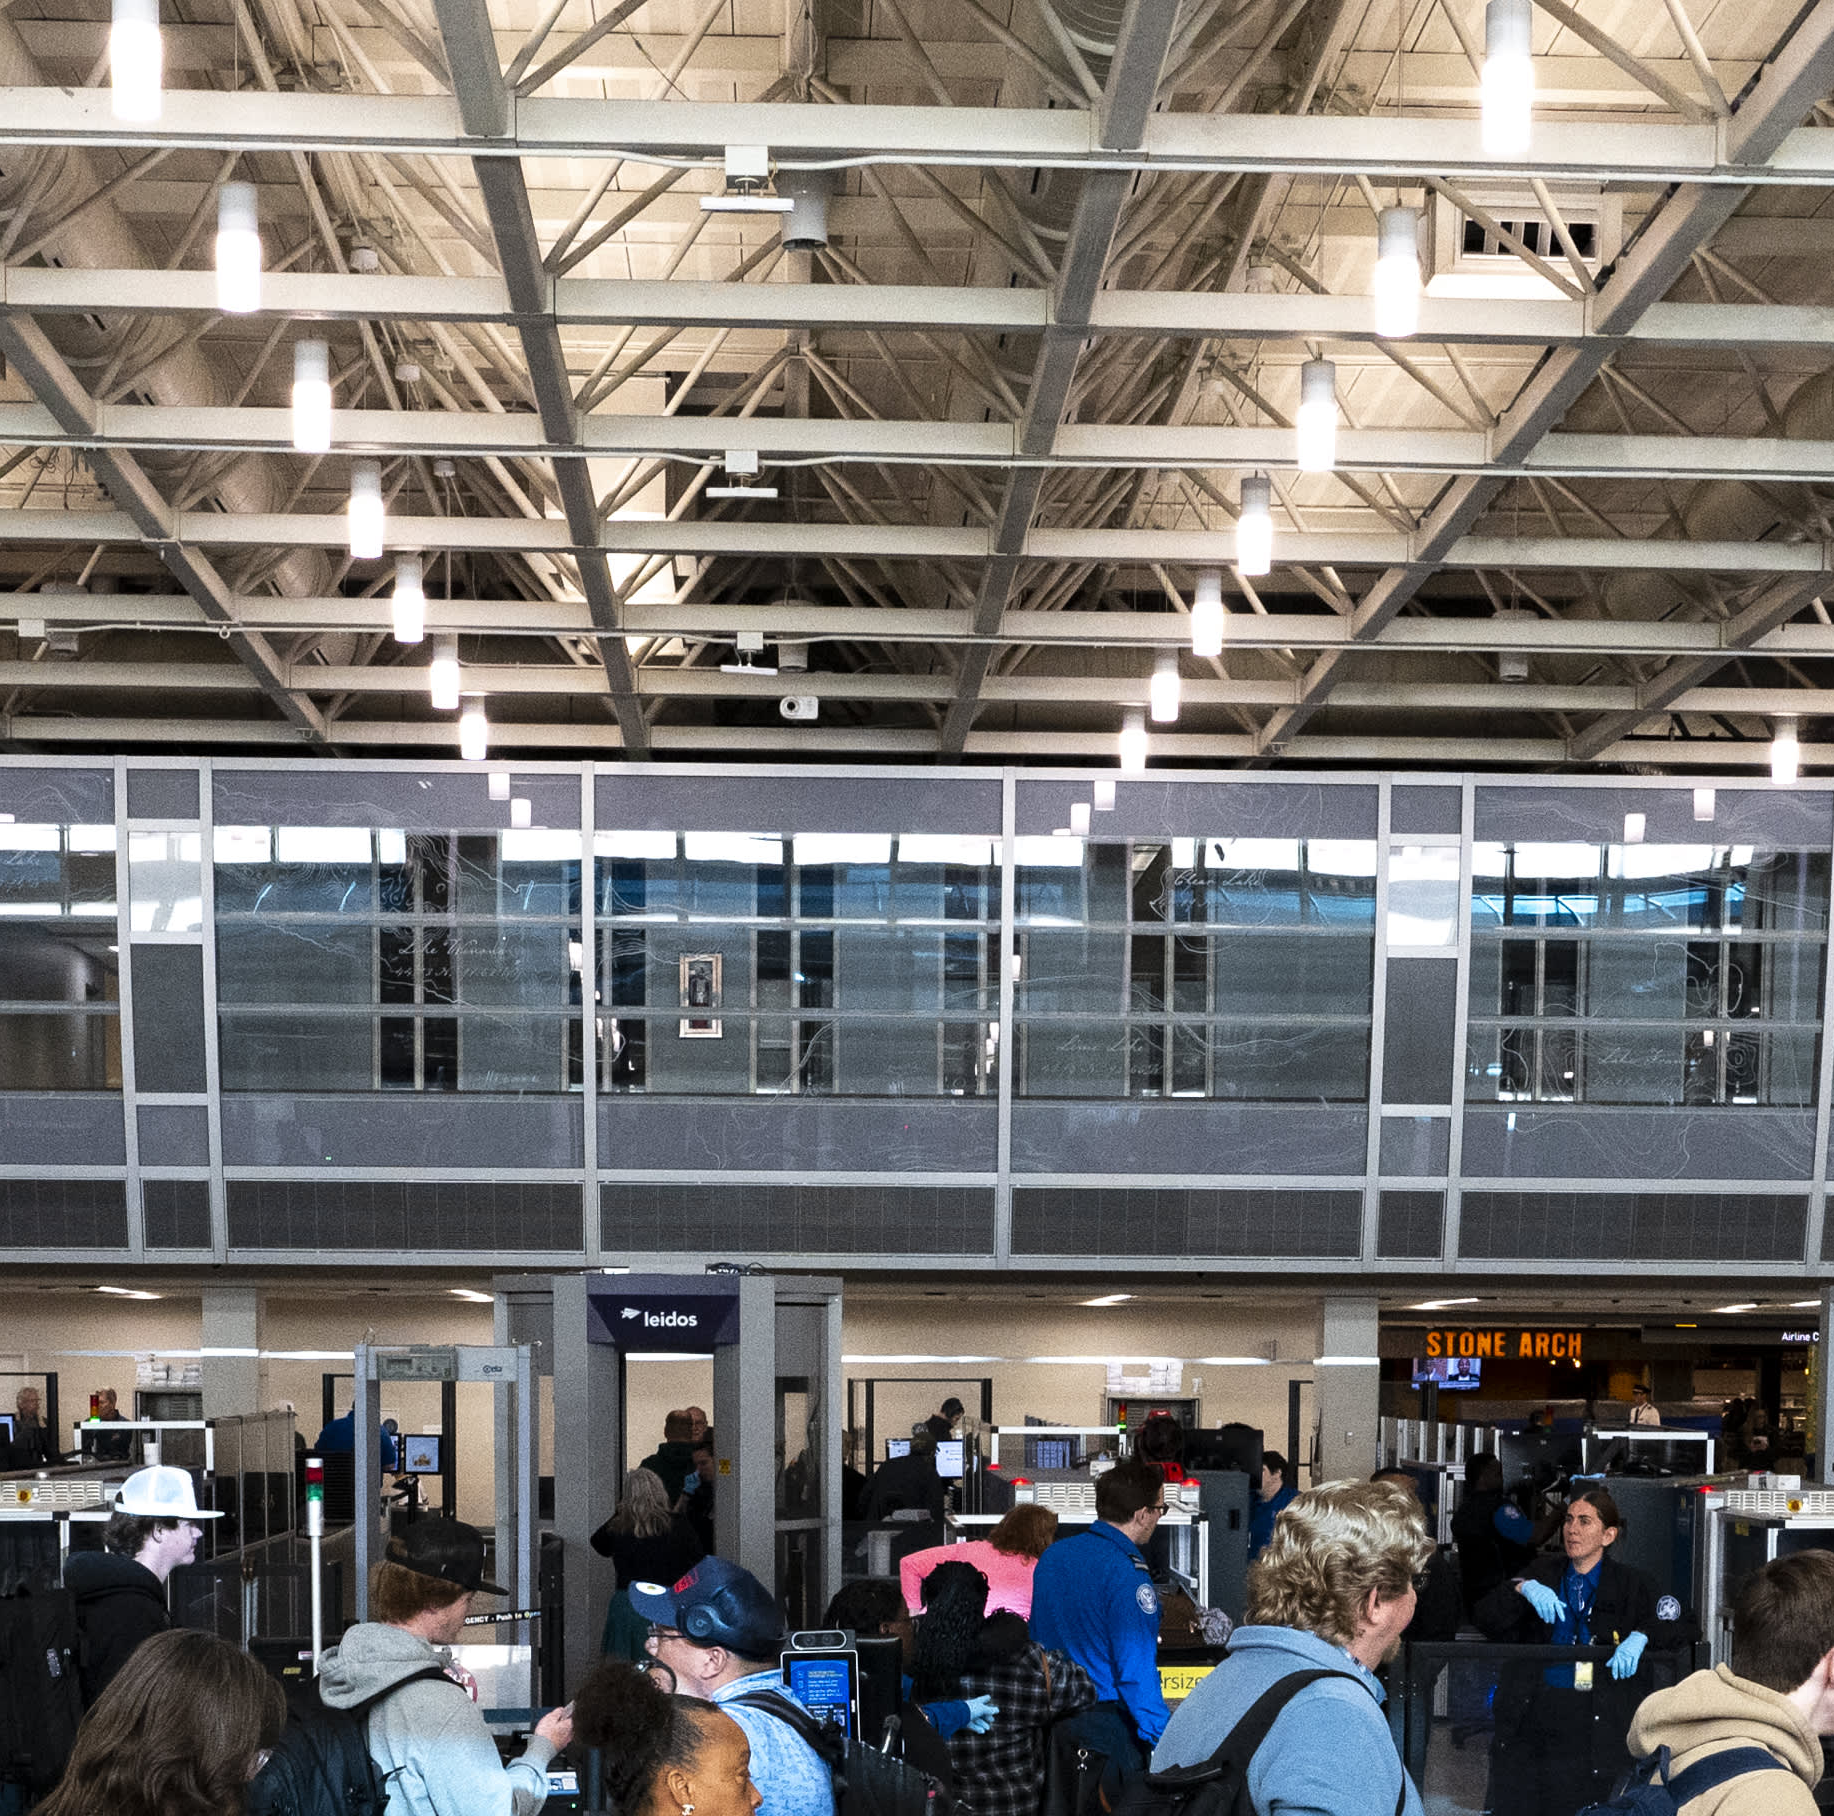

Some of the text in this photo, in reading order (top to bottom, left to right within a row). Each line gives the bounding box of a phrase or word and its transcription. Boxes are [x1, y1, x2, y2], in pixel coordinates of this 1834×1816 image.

[644, 1311, 698, 1328] leidos
[1782, 1332, 1811, 1342] Airline
[1426, 1332, 1582, 1358] STONE ARCH
[465, 1615, 488, 1624] GENCY
